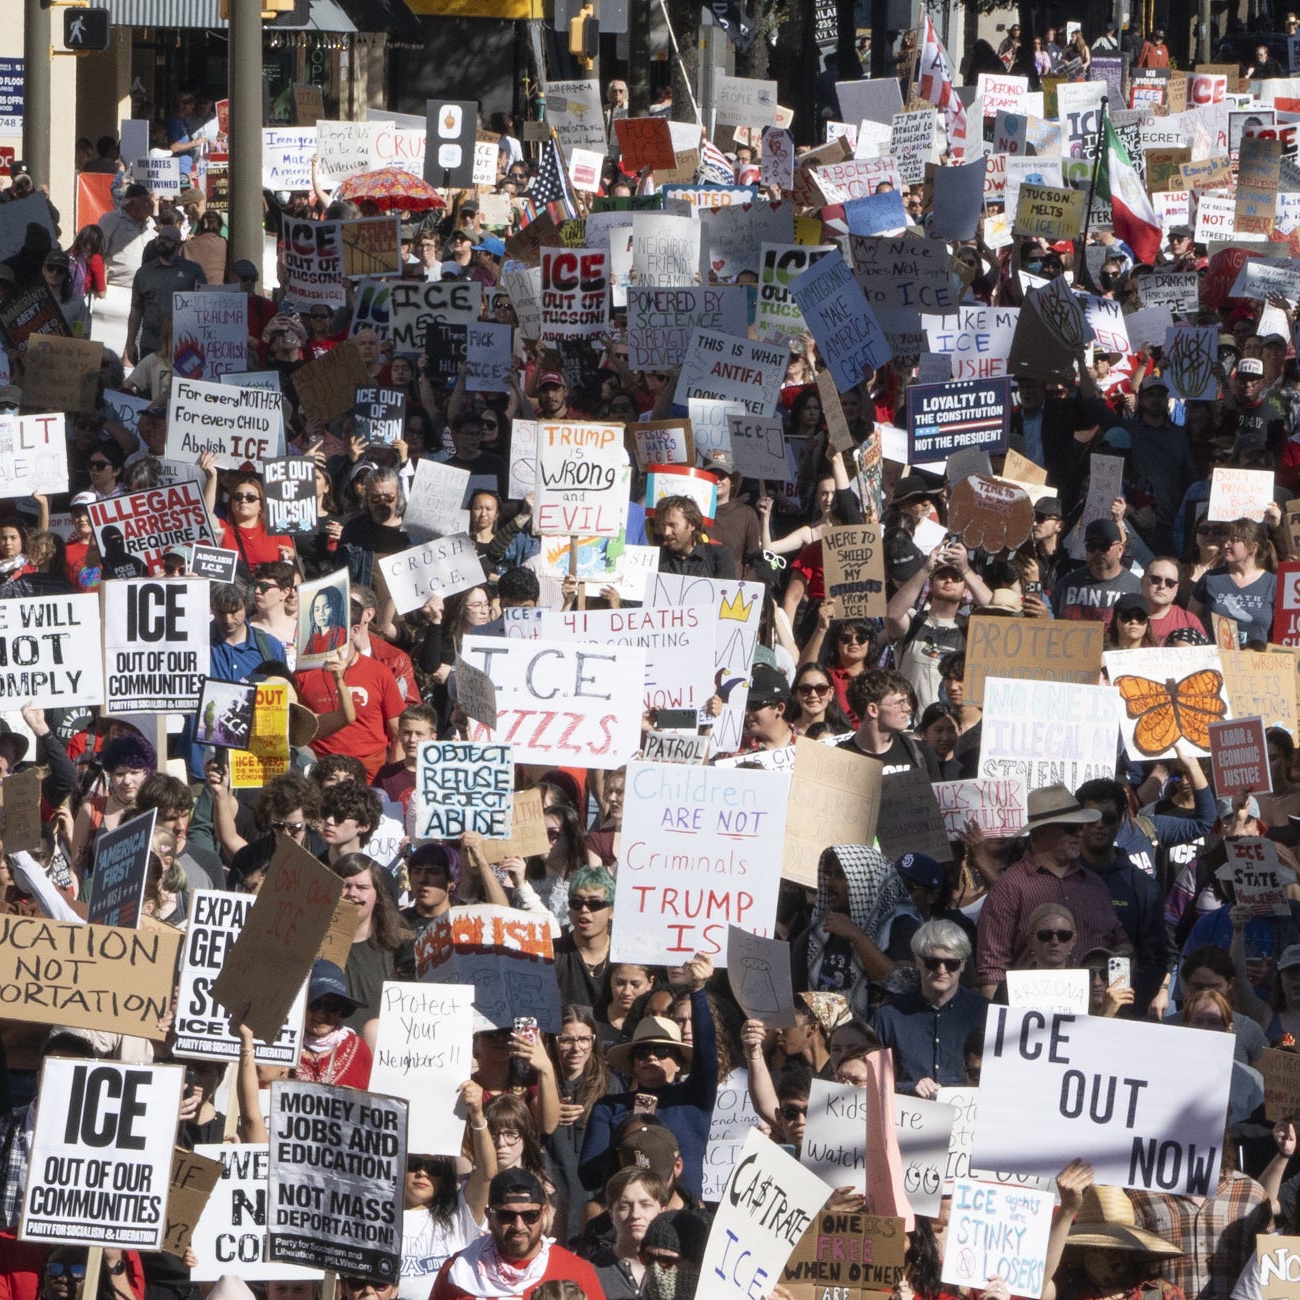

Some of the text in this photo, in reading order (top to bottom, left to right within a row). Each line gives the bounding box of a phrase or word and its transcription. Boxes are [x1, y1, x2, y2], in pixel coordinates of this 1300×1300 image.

[1026, 189, 1070, 202] TUCSON
[1031, 203, 1063, 218] MELTS
[916, 406, 1003, 425] THE CONSTITUTION
[923, 391, 995, 411] LOYALTY TO
[544, 426, 615, 449] TRUMP
[915, 429, 1002, 451] NOT THE PRESIDENT
[571, 448, 584, 459] IS
[539, 504, 613, 531] EVIL
[197, 553, 233, 566] ABOLISH
[391, 539, 463, 576] CRUSH
[661, 807, 768, 833] ARE NOT
[632, 886, 753, 923] TRUMP
[666, 924, 724, 954] IS
[15, 955, 97, 983] NOT
[993, 1008, 1076, 1064] ICE
[280, 1093, 397, 1130] MONEY FOR
[1059, 1070, 1148, 1128] OUT
[278, 1116, 397, 1157] JOBS AND
[278, 1143, 397, 1185] EDUCATION,
[1129, 1137, 1216, 1196] NOW
[278, 1183, 395, 1224] NOT MASS
[277, 1209, 393, 1245] DEPORTATION!
